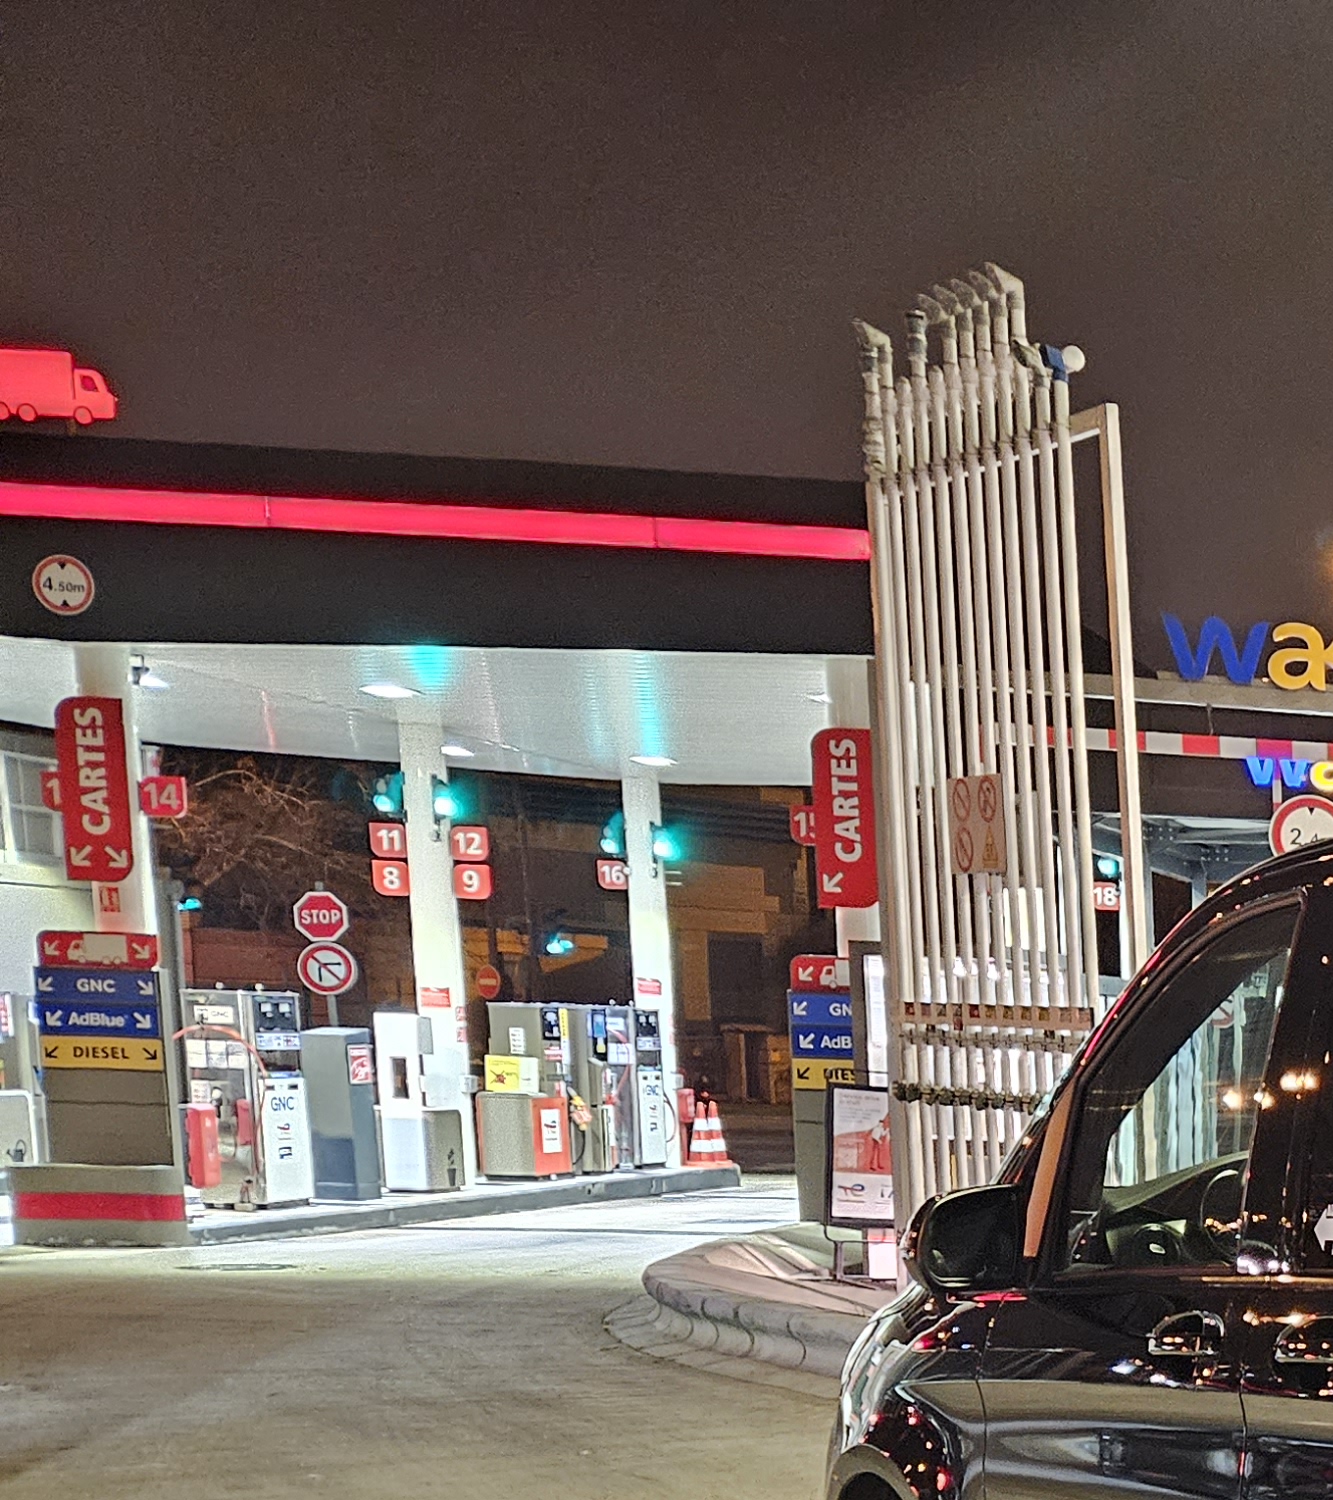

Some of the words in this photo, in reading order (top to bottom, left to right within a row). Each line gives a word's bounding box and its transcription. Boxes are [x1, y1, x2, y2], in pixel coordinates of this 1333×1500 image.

[73, 706, 111, 836] CARTES
[143, 782, 181, 811] 14
[829, 738, 862, 864] CARTES
[377, 829, 402, 852] 11
[453, 832, 483, 856] 12
[382, 866, 401, 890] 8
[462, 870, 480, 894] 9
[600, 865, 627, 886] 16
[1093, 886, 1118, 907] 18
[301, 909, 341, 925] STOP
[76, 978, 116, 993] GNC
[68, 1011, 125, 1028] AdBlue
[73, 1046, 129, 1060] DIESEL
[271, 1096, 295, 1112] GNC
